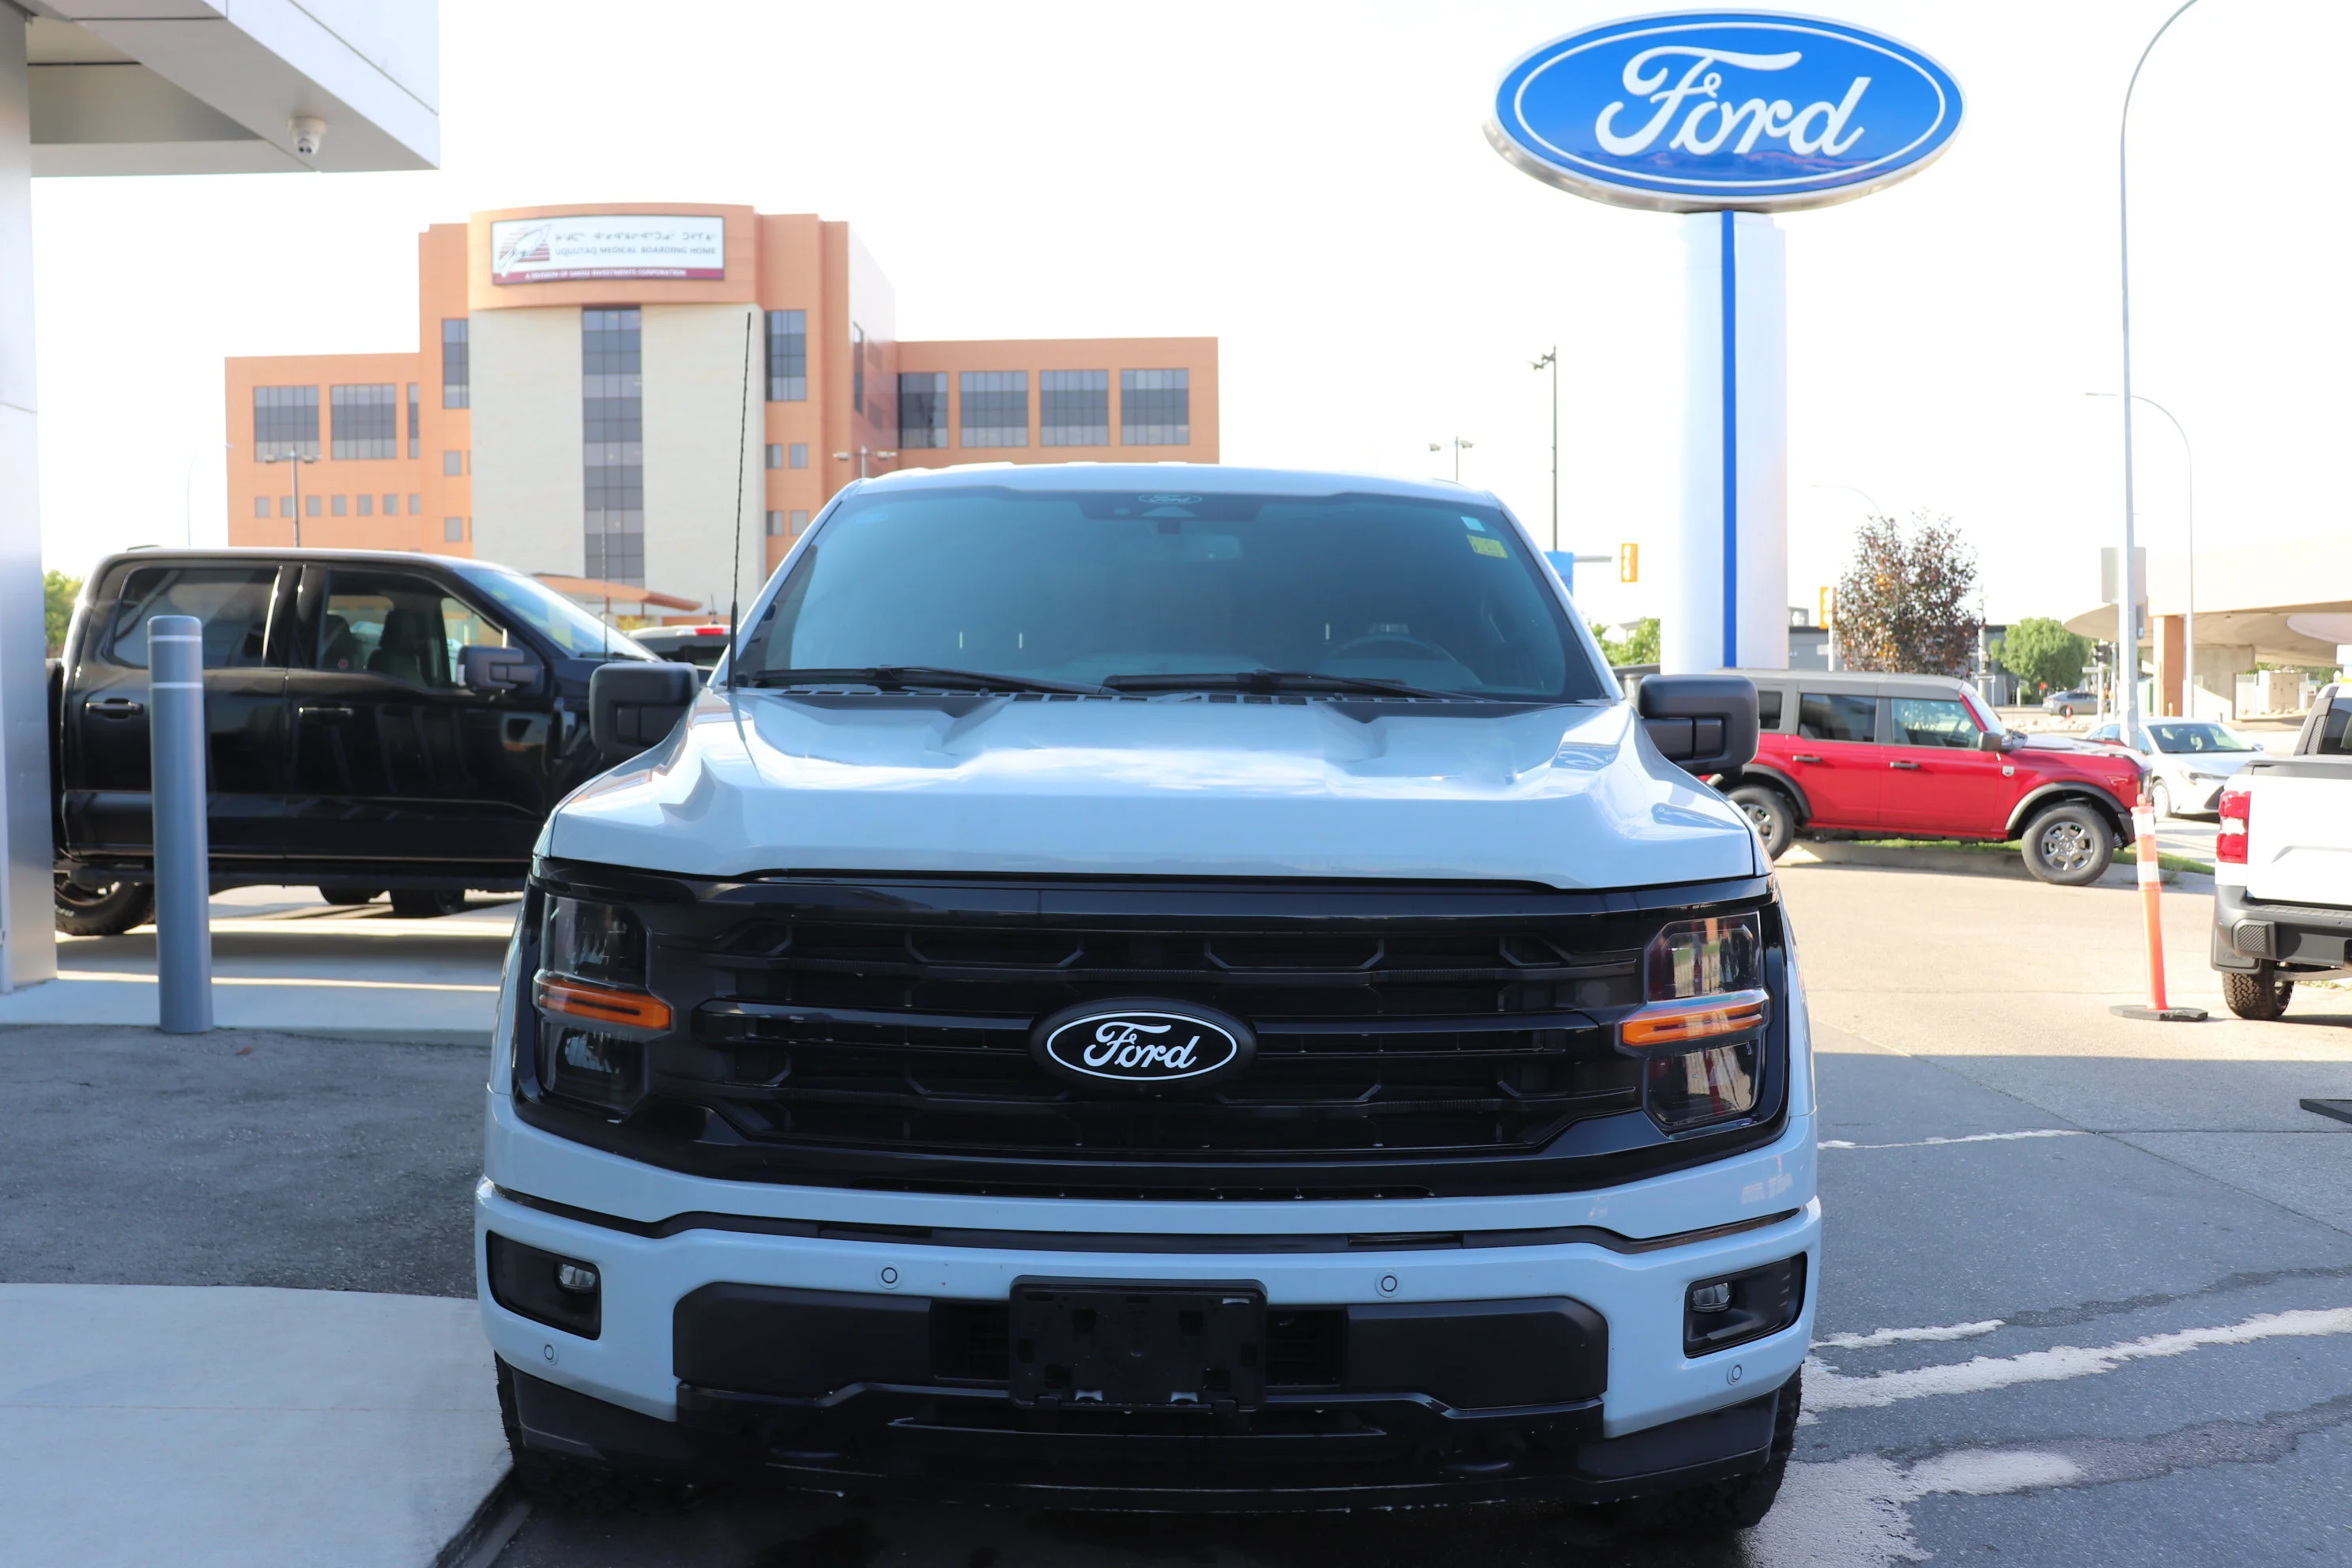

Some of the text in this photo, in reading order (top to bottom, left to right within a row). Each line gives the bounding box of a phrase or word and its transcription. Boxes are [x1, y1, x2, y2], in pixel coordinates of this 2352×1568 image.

[1595, 45, 1871, 156] Ford
[690, 246, 716, 254] HOME
[1083, 1021, 1200, 1069] Ford
